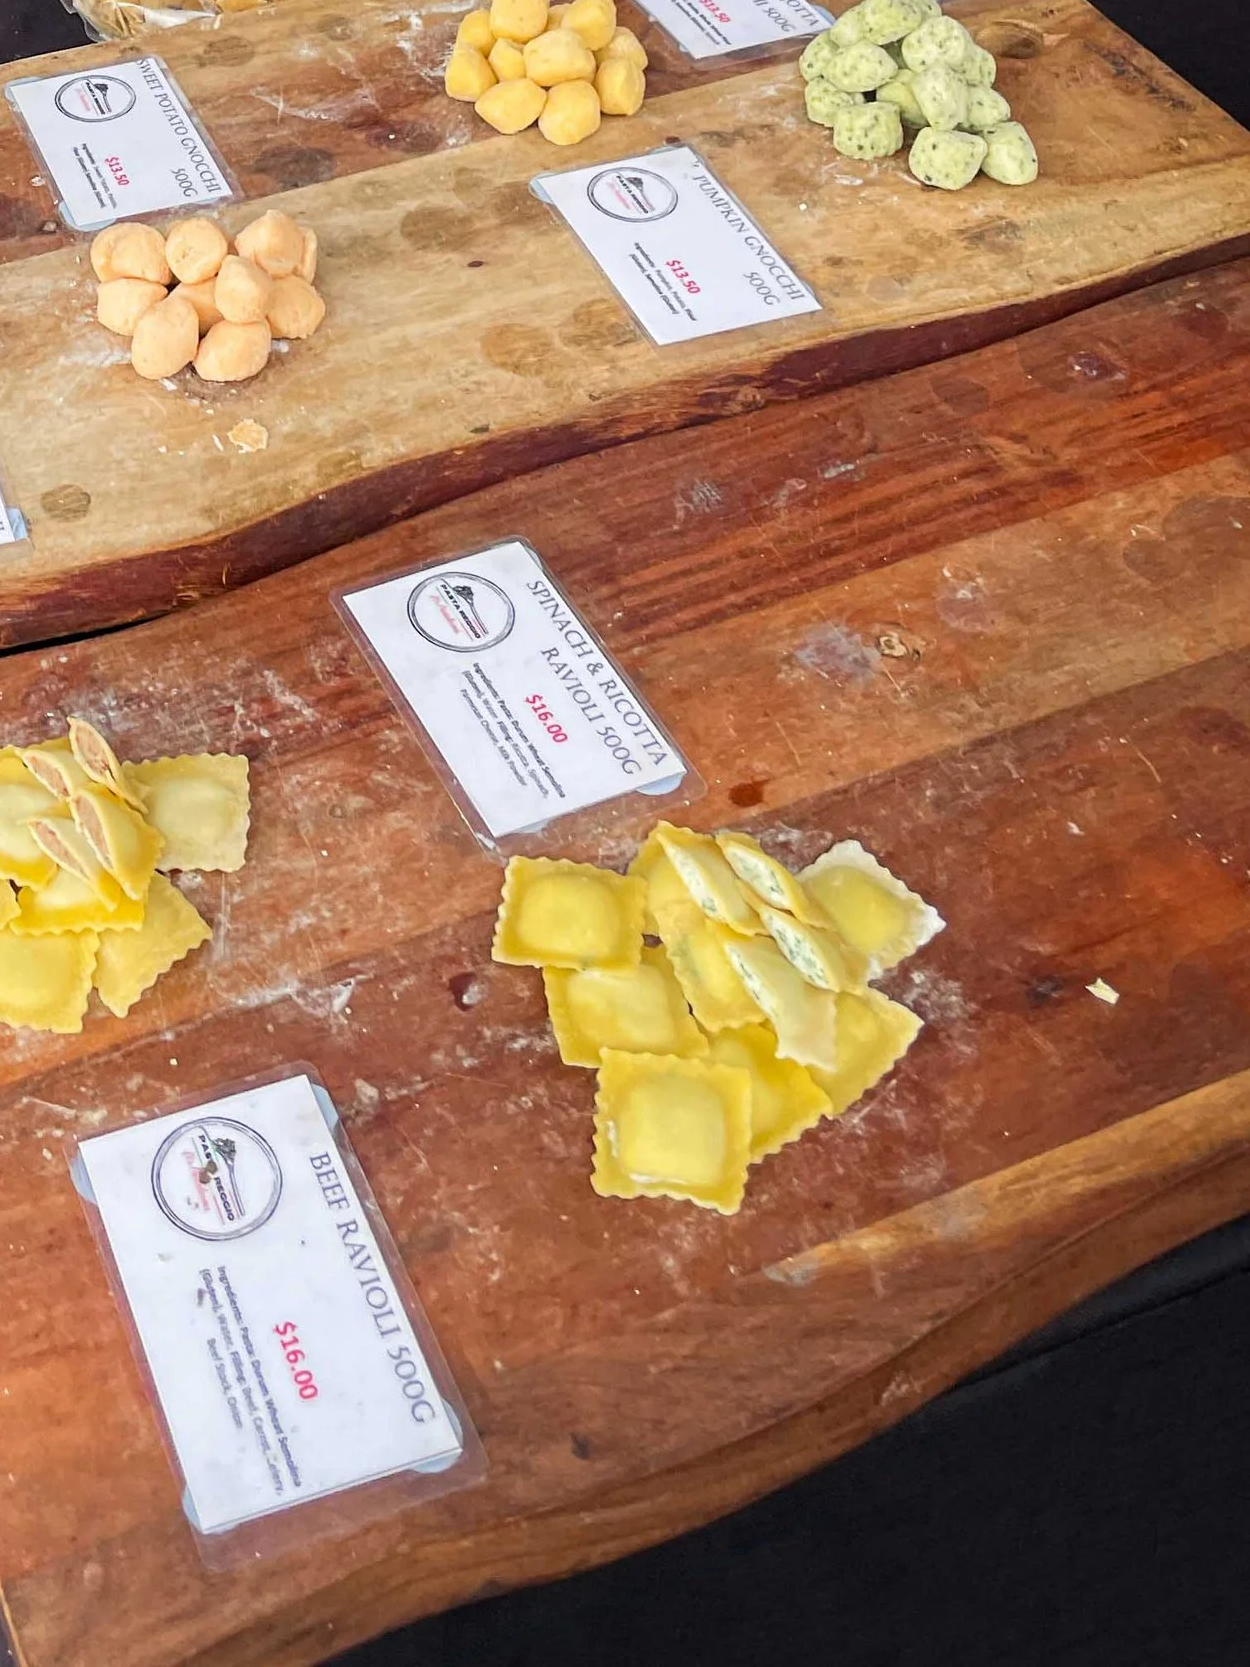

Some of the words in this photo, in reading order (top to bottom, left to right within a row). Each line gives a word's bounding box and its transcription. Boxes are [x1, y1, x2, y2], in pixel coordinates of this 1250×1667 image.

[133, 58, 165, 92] SWEET
[153, 92, 190, 136] POTATO
[177, 136, 222, 193] GNOCCHI
[102, 155, 132, 187] $13.50
[169, 166, 199, 198] 500G
[690, 174, 751, 234] PUMPKIN
[740, 234, 807, 300] GNOCCHI
[740, 270, 782, 306] 500G
[438, 583, 463, 611] PASTA
[456, 609, 482, 639] REGGIO
[523, 578, 595, 659] SPINACH
[583, 659, 607, 677] &
[596, 677, 672, 766] RICOTTA
[538, 645, 606, 723] RAVIOLI
[594, 724, 644, 777] 500G
[522, 692, 571, 745] $16.00
[195, 1133, 220, 1178] PAS
[211, 1175, 237, 1223] REGGIO
[306, 1149, 351, 1215] BEEF
[333, 1216, 403, 1340] RAVIOLI
[384, 1341, 438, 1426] 500G
[204, 1336, 223, 1363] Beef
[269, 1317, 323, 1404] $16.00
[249, 1358, 272, 1398] Durum
[263, 1397, 285, 1436] Wheat
[276, 1435, 305, 1489] Semolina
